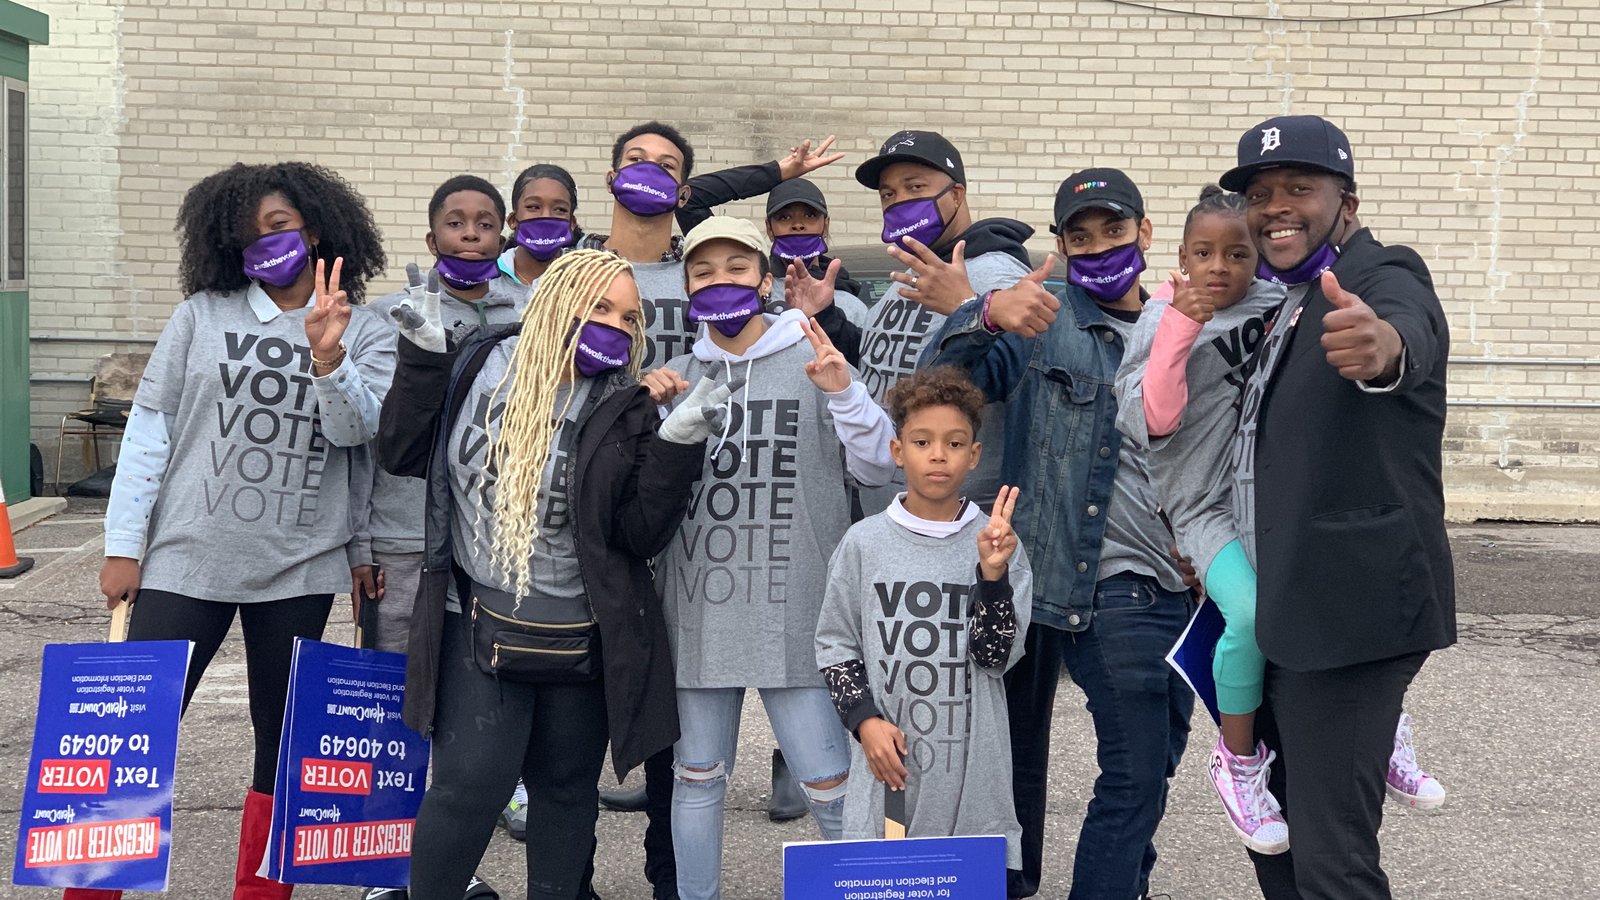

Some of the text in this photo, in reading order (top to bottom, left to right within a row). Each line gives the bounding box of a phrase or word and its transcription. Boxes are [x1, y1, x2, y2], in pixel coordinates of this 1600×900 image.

[622, 182, 667, 199] #walkthevote
[1081, 266, 1134, 284] #walkthevote
[697, 308, 751, 321] #walkthevote
[224, 332, 311, 373] VOT
[579, 343, 623, 366] #walkthevote
[861, 330, 922, 369] VOTE
[219, 363, 319, 414] VOT
[216, 402, 324, 453] VOTE
[712, 399, 799, 438] OTE
[210, 441, 324, 490] VOTE
[710, 439, 797, 479] OTE
[204, 479, 319, 527] VOTE
[680, 524, 791, 563] VOTE
[679, 566, 788, 605] VOTE
[874, 581, 969, 620] VOT
[877, 620, 969, 657] VOT
[72, 674, 152, 683] and Election Information
[76, 684, 146, 695] for Voter Registration
[327, 677, 405, 692] and Election Information
[130, 703, 146, 713] visit
[333, 688, 400, 703] for Voter Registration
[387, 710, 402, 720] visit
[59, 734, 150, 755] to 40649
[319, 734, 406, 760] to 40649
[41, 766, 159, 788] Text VOTER
[304, 765, 415, 792] Text VOTER
[29, 822, 155, 863] REGISTER TO VOTE
[296, 822, 411, 862] REGISTER TO VOTE
[834, 875, 958, 888] and Election Information
[844, 888, 951, 900] for Voter Registration
